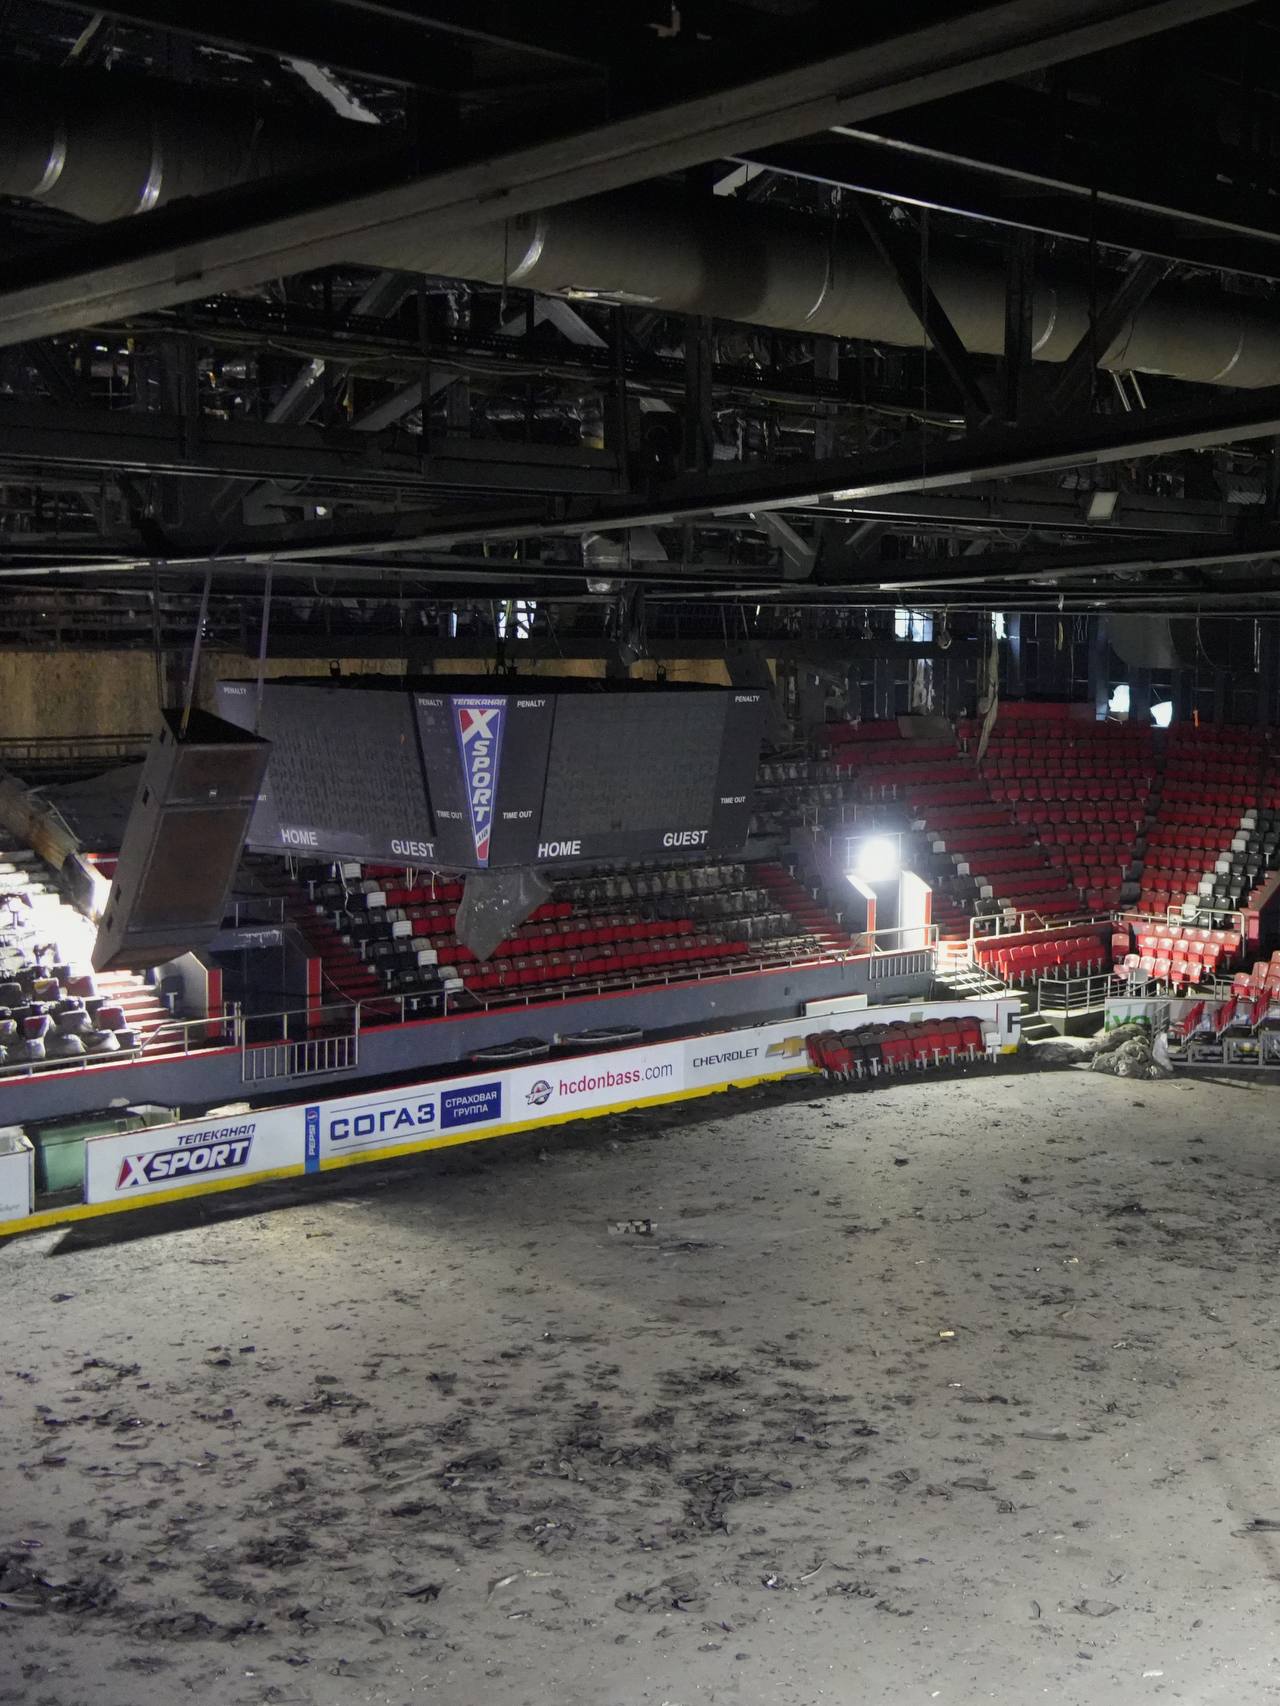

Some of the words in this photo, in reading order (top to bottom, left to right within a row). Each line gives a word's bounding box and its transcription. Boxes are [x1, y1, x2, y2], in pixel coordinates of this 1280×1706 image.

[223, 687, 248, 695] PENALTY
[418, 698, 443, 706] PENALTY
[517, 699, 546, 708] PENALTY
[734, 695, 760, 703] PENALTY
[721, 797, 734, 805] TIME
[734, 796, 746, 804] OUT
[436, 810, 450, 818] TIME
[451, 811, 463, 819] OUT
[503, 811, 518, 819] TIME
[519, 810, 533, 818] OUT
[281, 829, 318, 846] HOME
[663, 830, 708, 847] GUEST
[391, 839, 434, 858] GUEST
[538, 840, 581, 858] HOME
[692, 1047, 760, 1068] CHEVROLET
[559, 1063, 673, 1096] hcdonbass.com
[445, 1091, 498, 1108] СТРАХОВАЯ
[453, 1104, 489, 1118] ГРУППА
[330, 1102, 436, 1141] СОГАЗ
